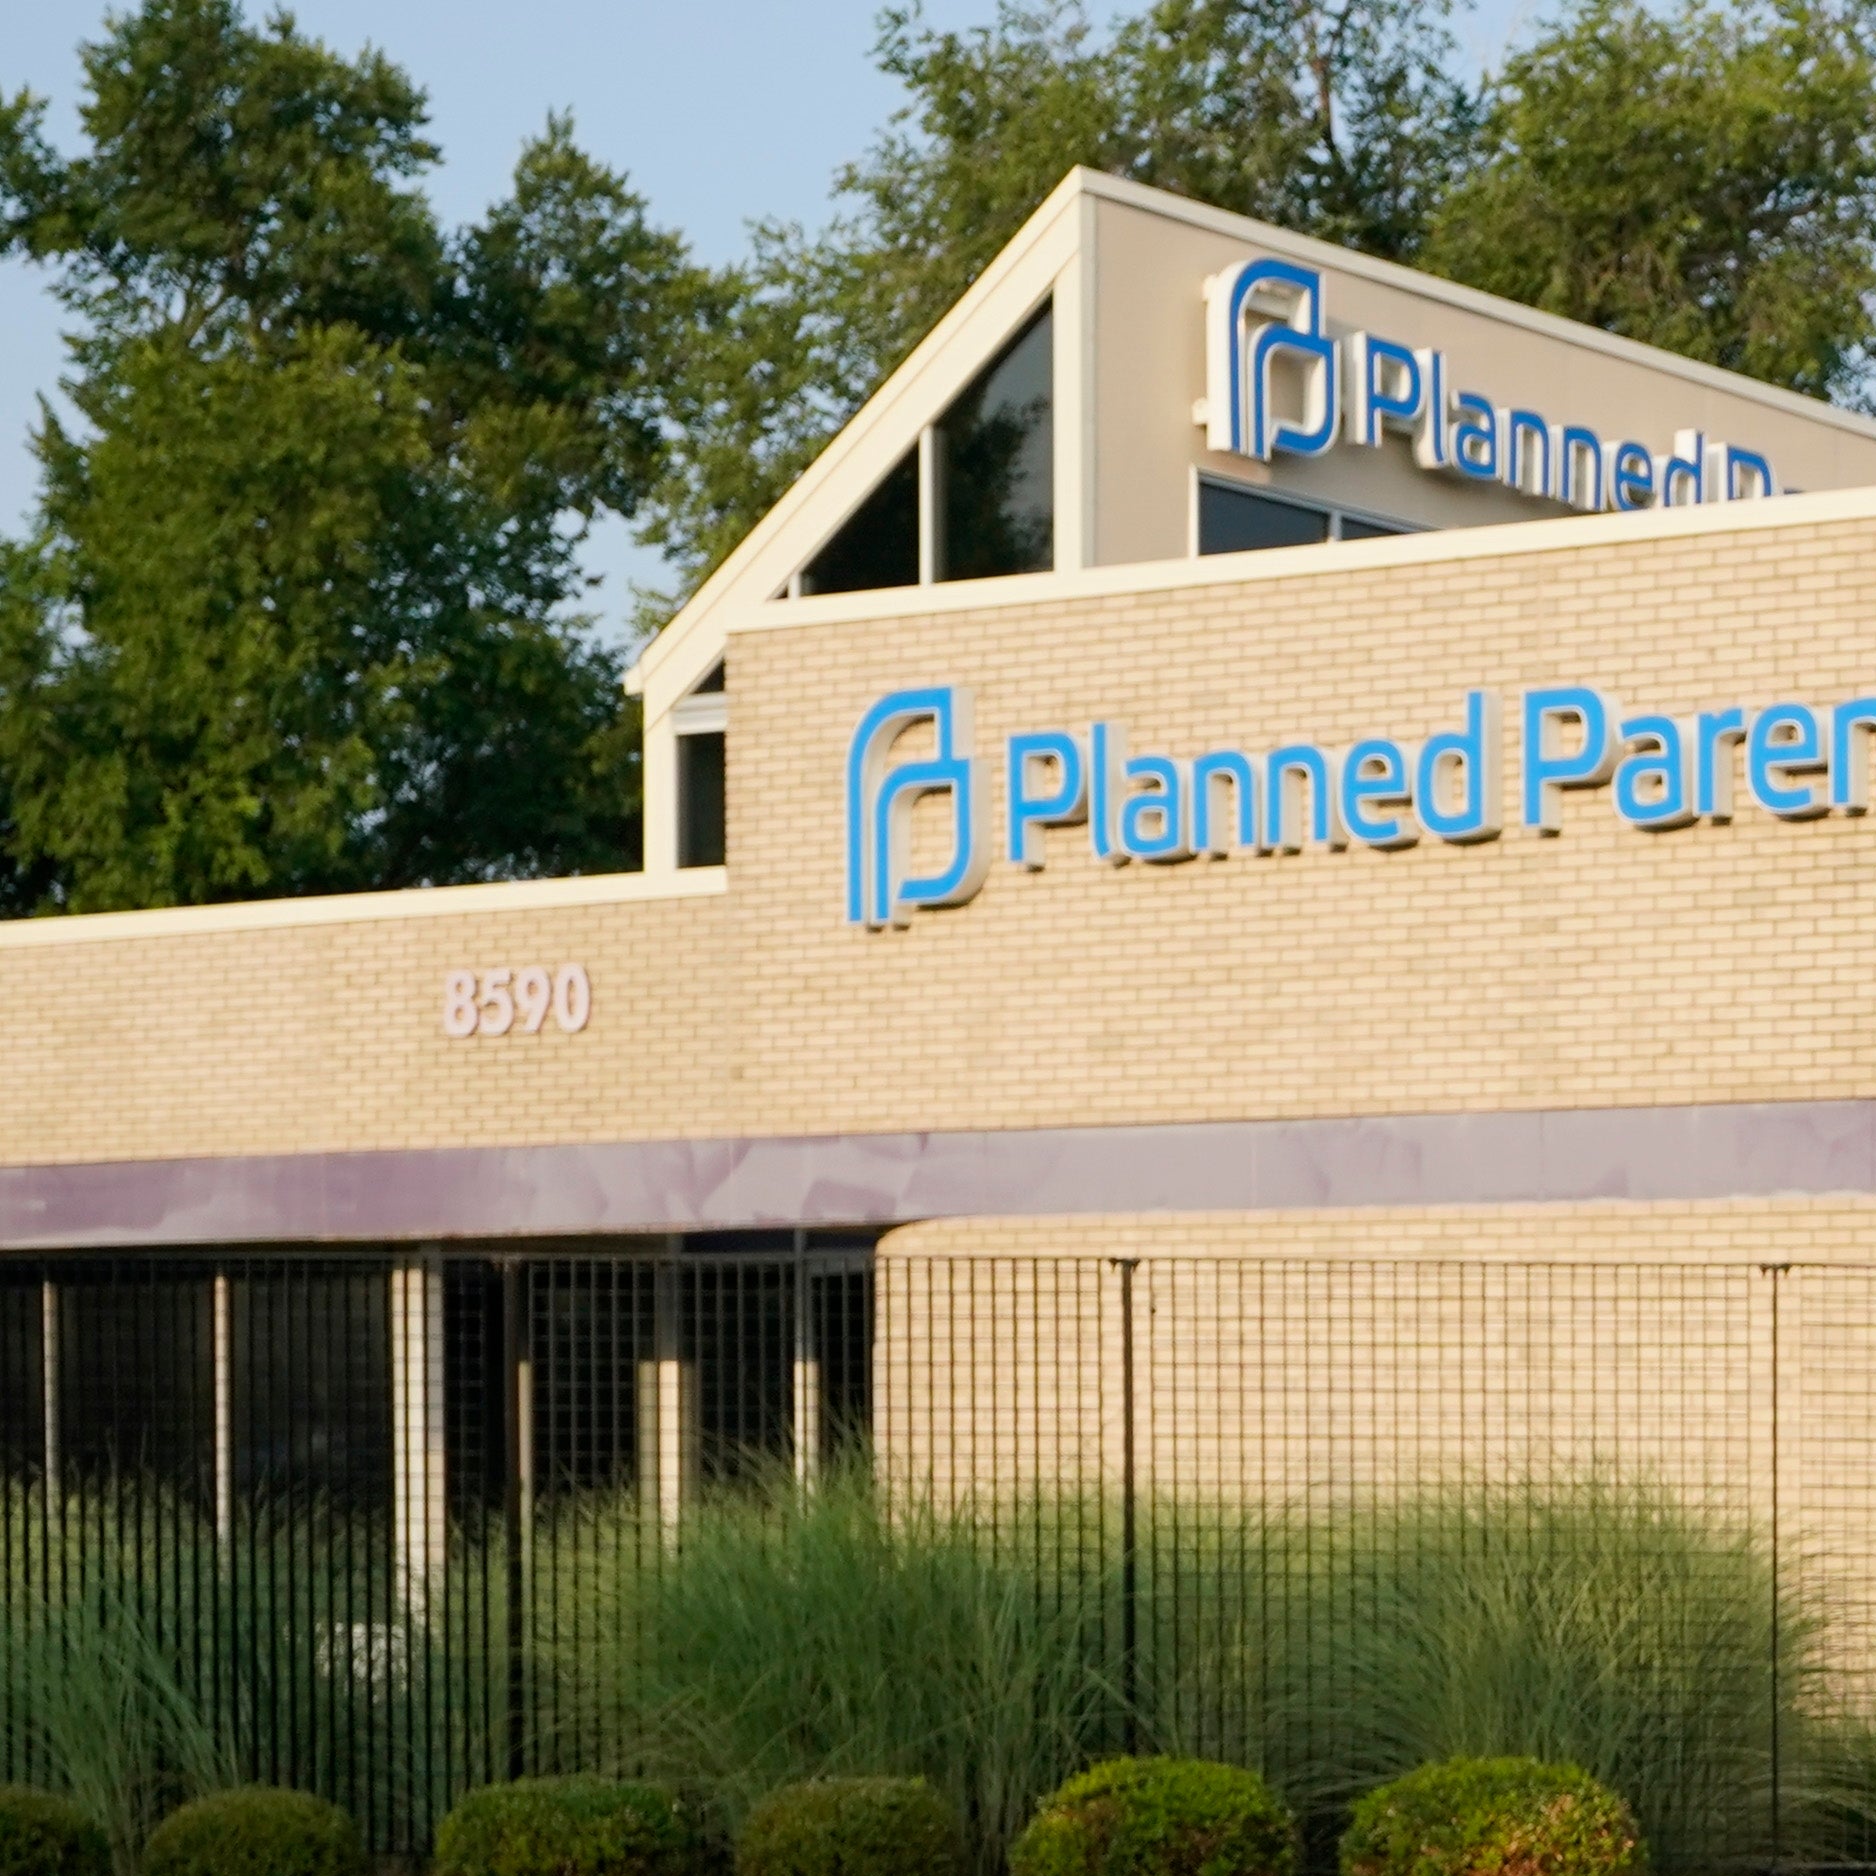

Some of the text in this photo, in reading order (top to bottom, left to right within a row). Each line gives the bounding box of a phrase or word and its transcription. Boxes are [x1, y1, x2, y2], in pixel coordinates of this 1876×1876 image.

[1360, 332, 1704, 511] Planned
[1006, 690, 1490, 862] Planned
[445, 962, 592, 1037] 8590
